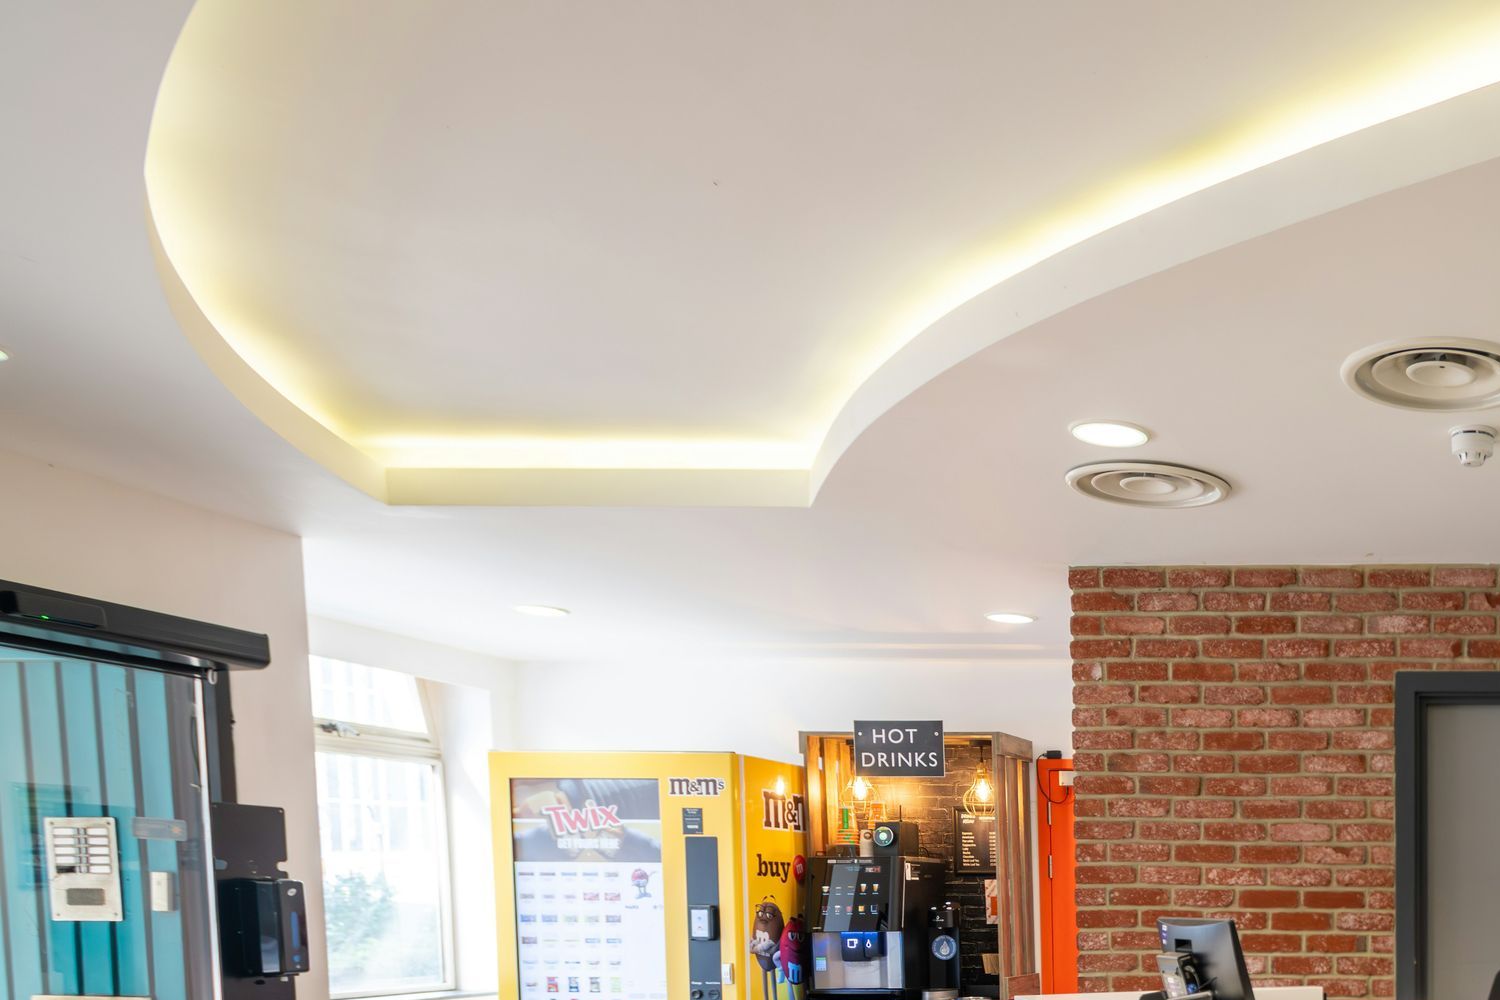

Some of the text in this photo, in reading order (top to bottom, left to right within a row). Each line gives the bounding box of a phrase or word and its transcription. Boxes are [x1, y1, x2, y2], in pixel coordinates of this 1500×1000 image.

[872, 728, 918, 744] HOT
[861, 752, 938, 768] DRINKS
[757, 853, 790, 883] buy
